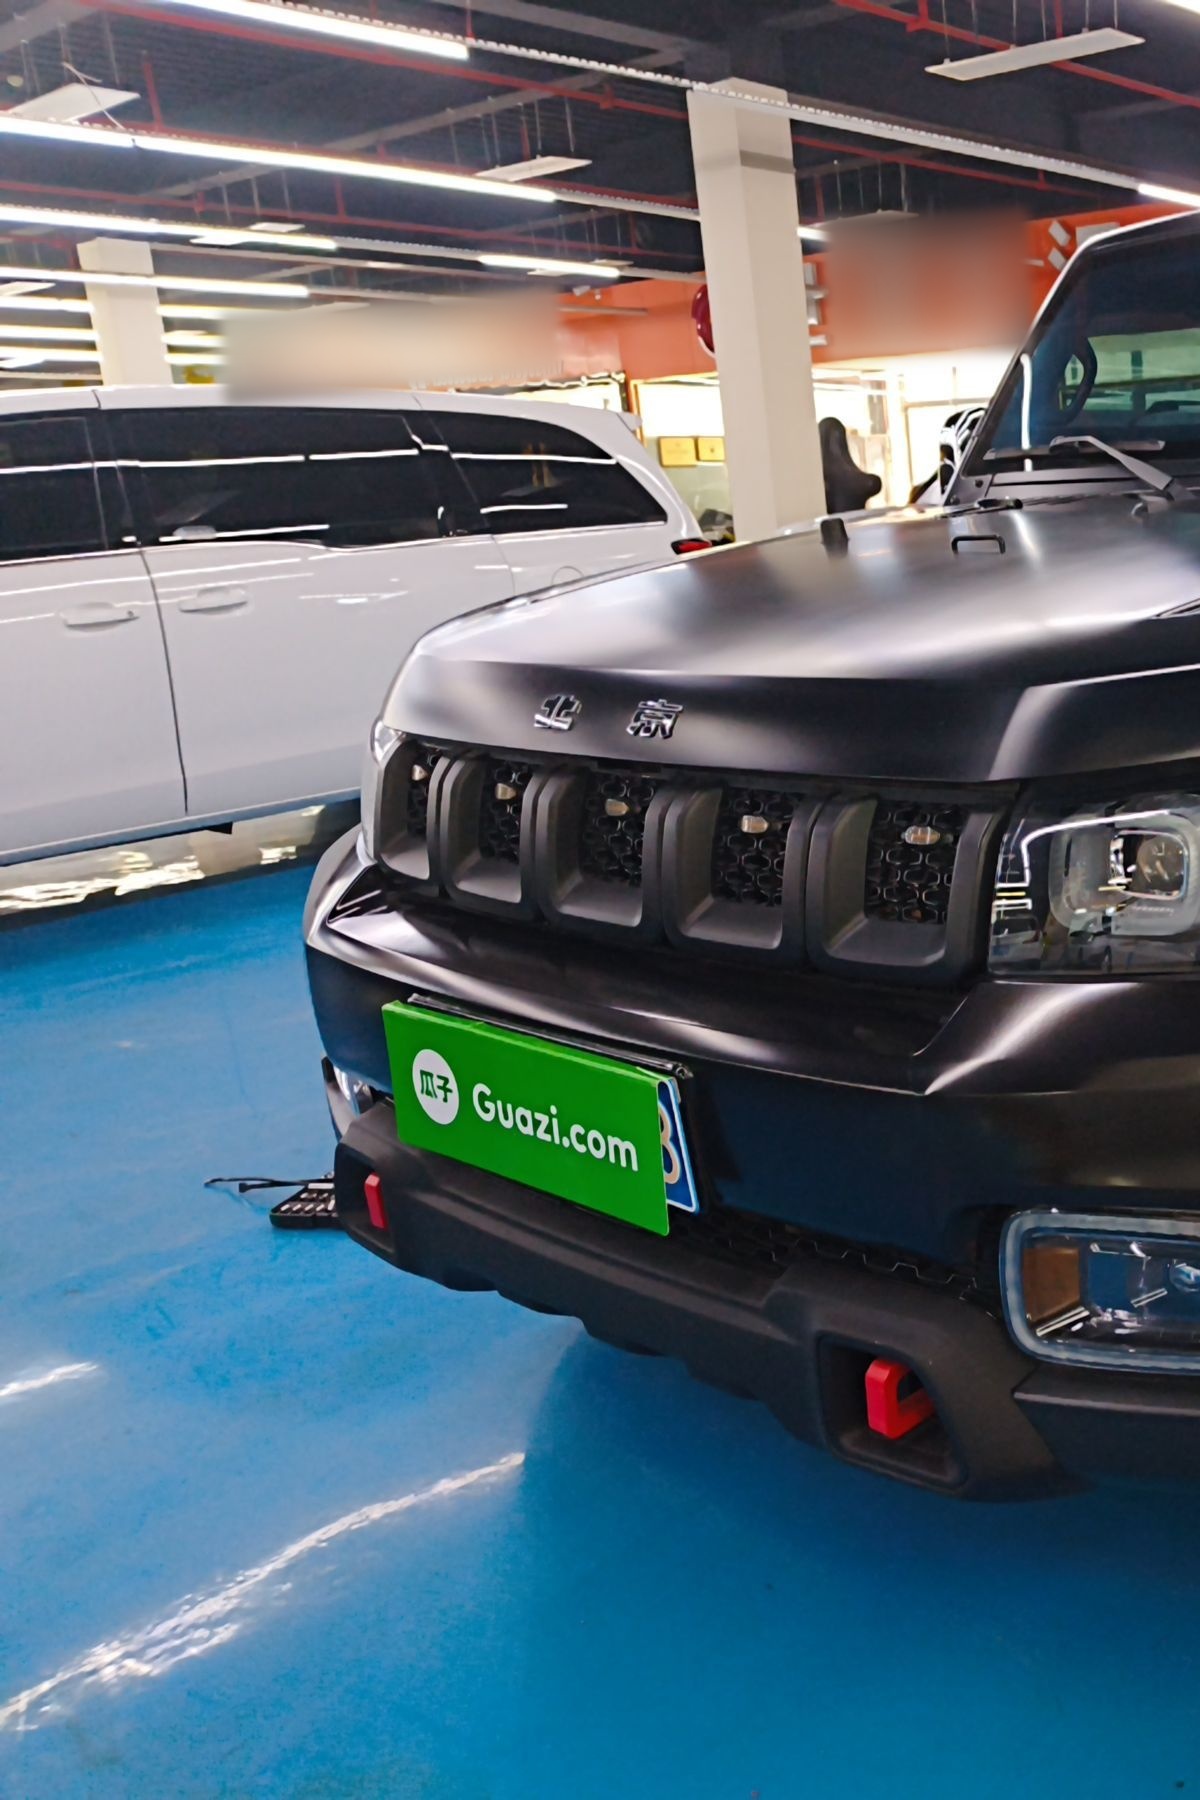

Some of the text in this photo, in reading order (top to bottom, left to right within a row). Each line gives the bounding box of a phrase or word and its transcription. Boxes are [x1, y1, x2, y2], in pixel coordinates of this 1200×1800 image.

[534, 694, 684, 740] 北京
[419, 1069, 454, 1103] 瓜子
[472, 1083, 639, 1172] Guazi.com
